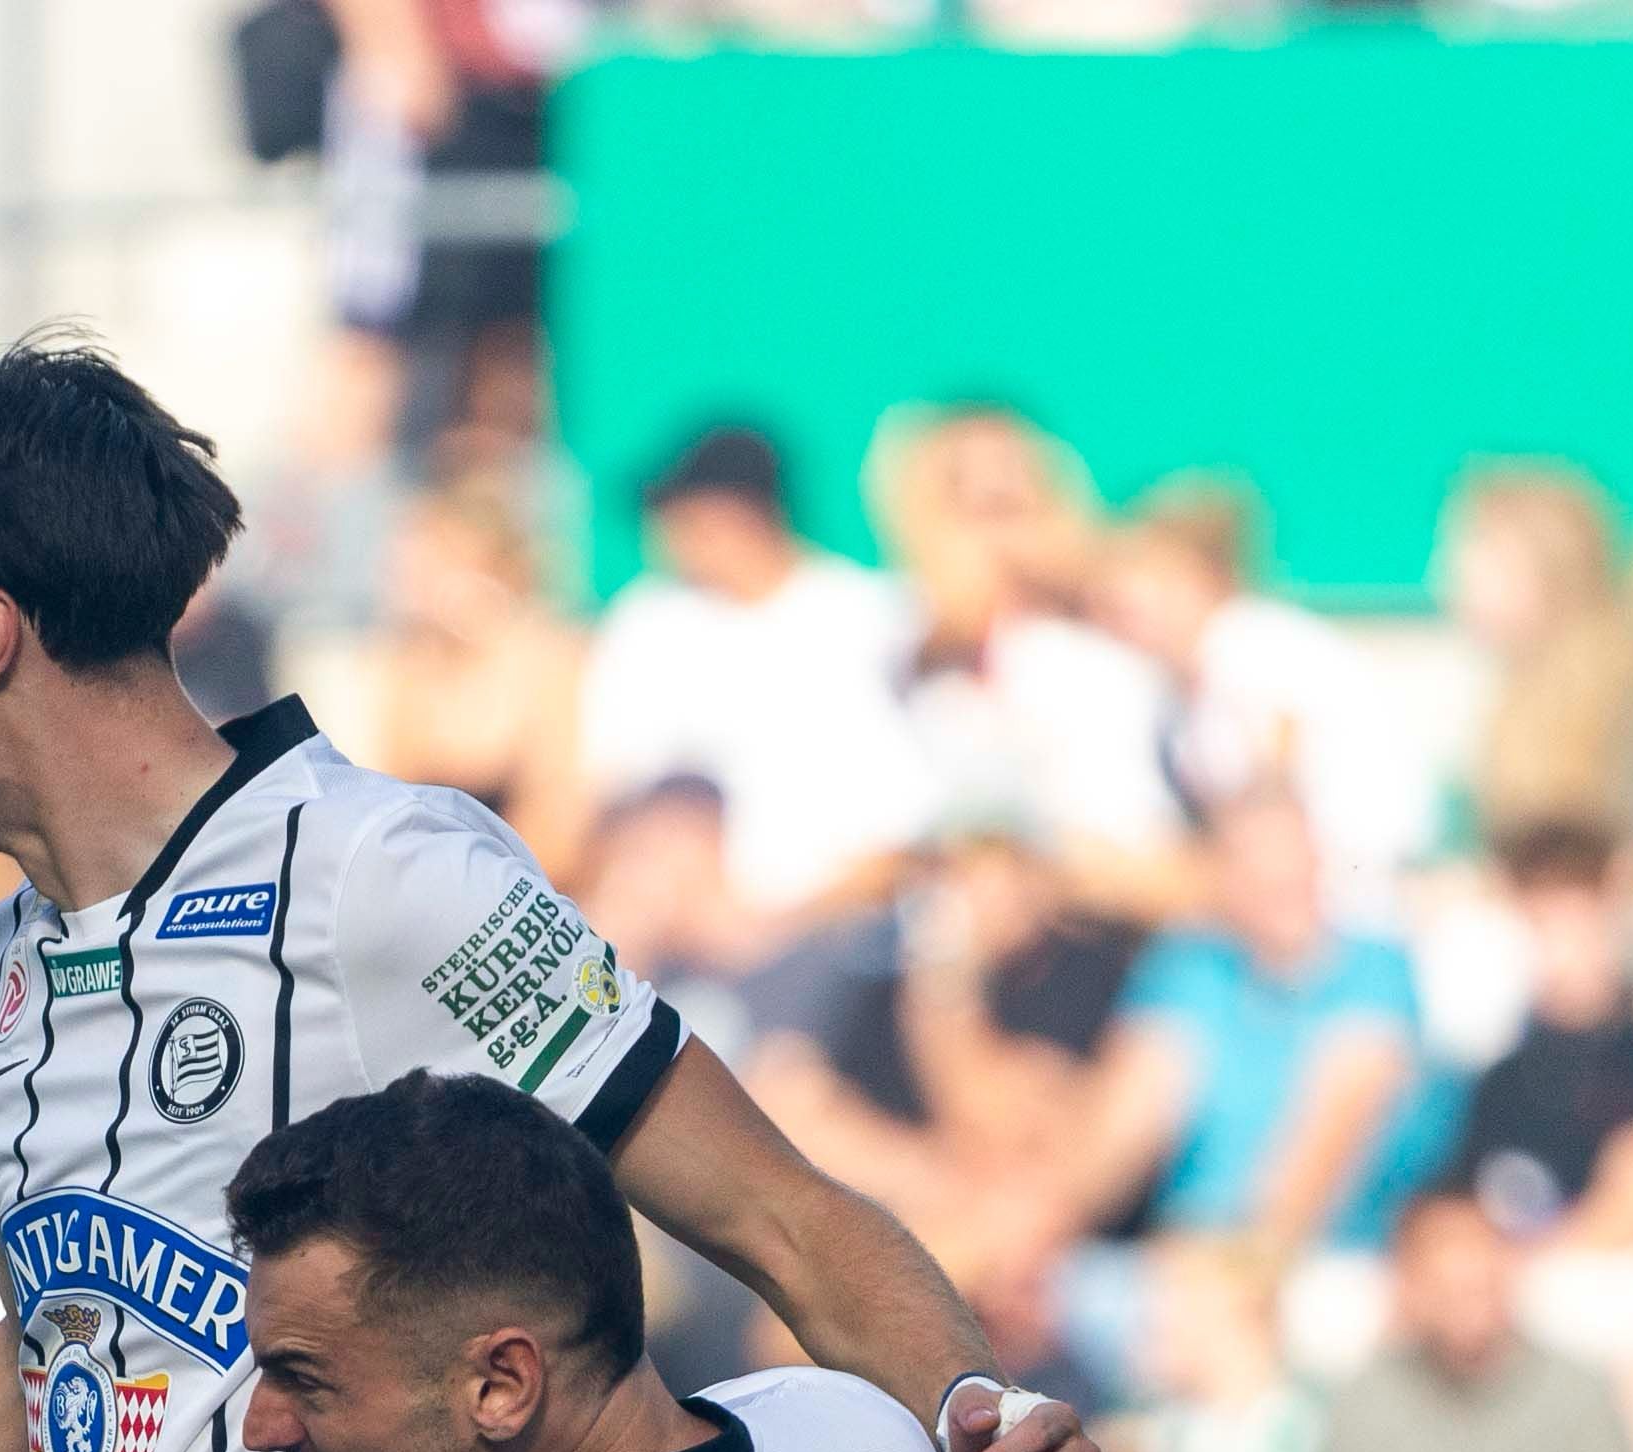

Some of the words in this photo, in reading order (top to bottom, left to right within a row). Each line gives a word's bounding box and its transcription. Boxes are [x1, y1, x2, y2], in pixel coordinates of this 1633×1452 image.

[172, 888, 270, 923] pure
[165, 917, 264, 934] encapsulations
[421, 877, 533, 994] STEIRISCHES
[438, 891, 559, 1020] KÜRBIS
[67, 959, 121, 995] GRAWE
[463, 917, 583, 1042] KERNÖL
[181, 1004, 207, 1017] STURM
[208, 1008, 231, 1029] GRAZ
[487, 991, 568, 1070] g.g.A.
[166, 1103, 183, 1116] SEIT
[184, 1104, 205, 1116] 1909
